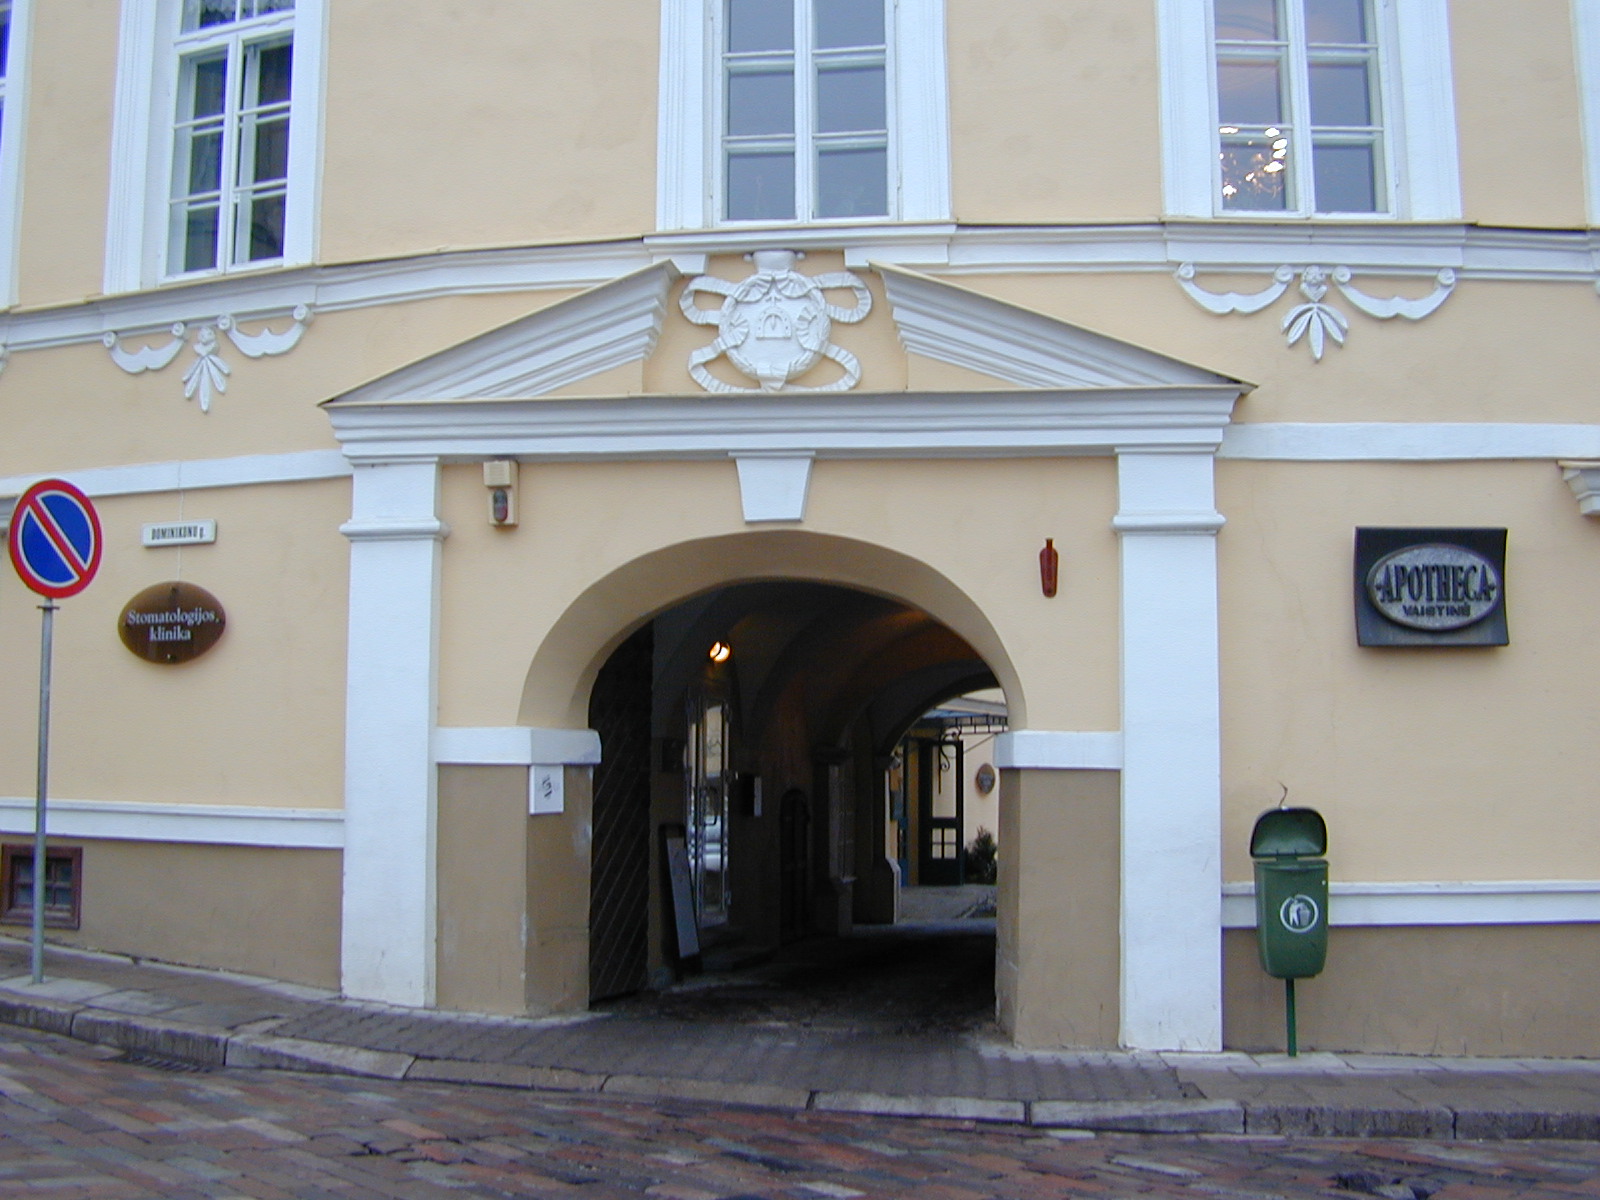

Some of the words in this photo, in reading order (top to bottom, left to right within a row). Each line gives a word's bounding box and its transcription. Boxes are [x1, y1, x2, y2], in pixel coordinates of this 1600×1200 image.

[1381, 564, 1492, 603] APOTHECA
[127, 607, 216, 626] Stomatologijos
[149, 625, 192, 642] klinika
